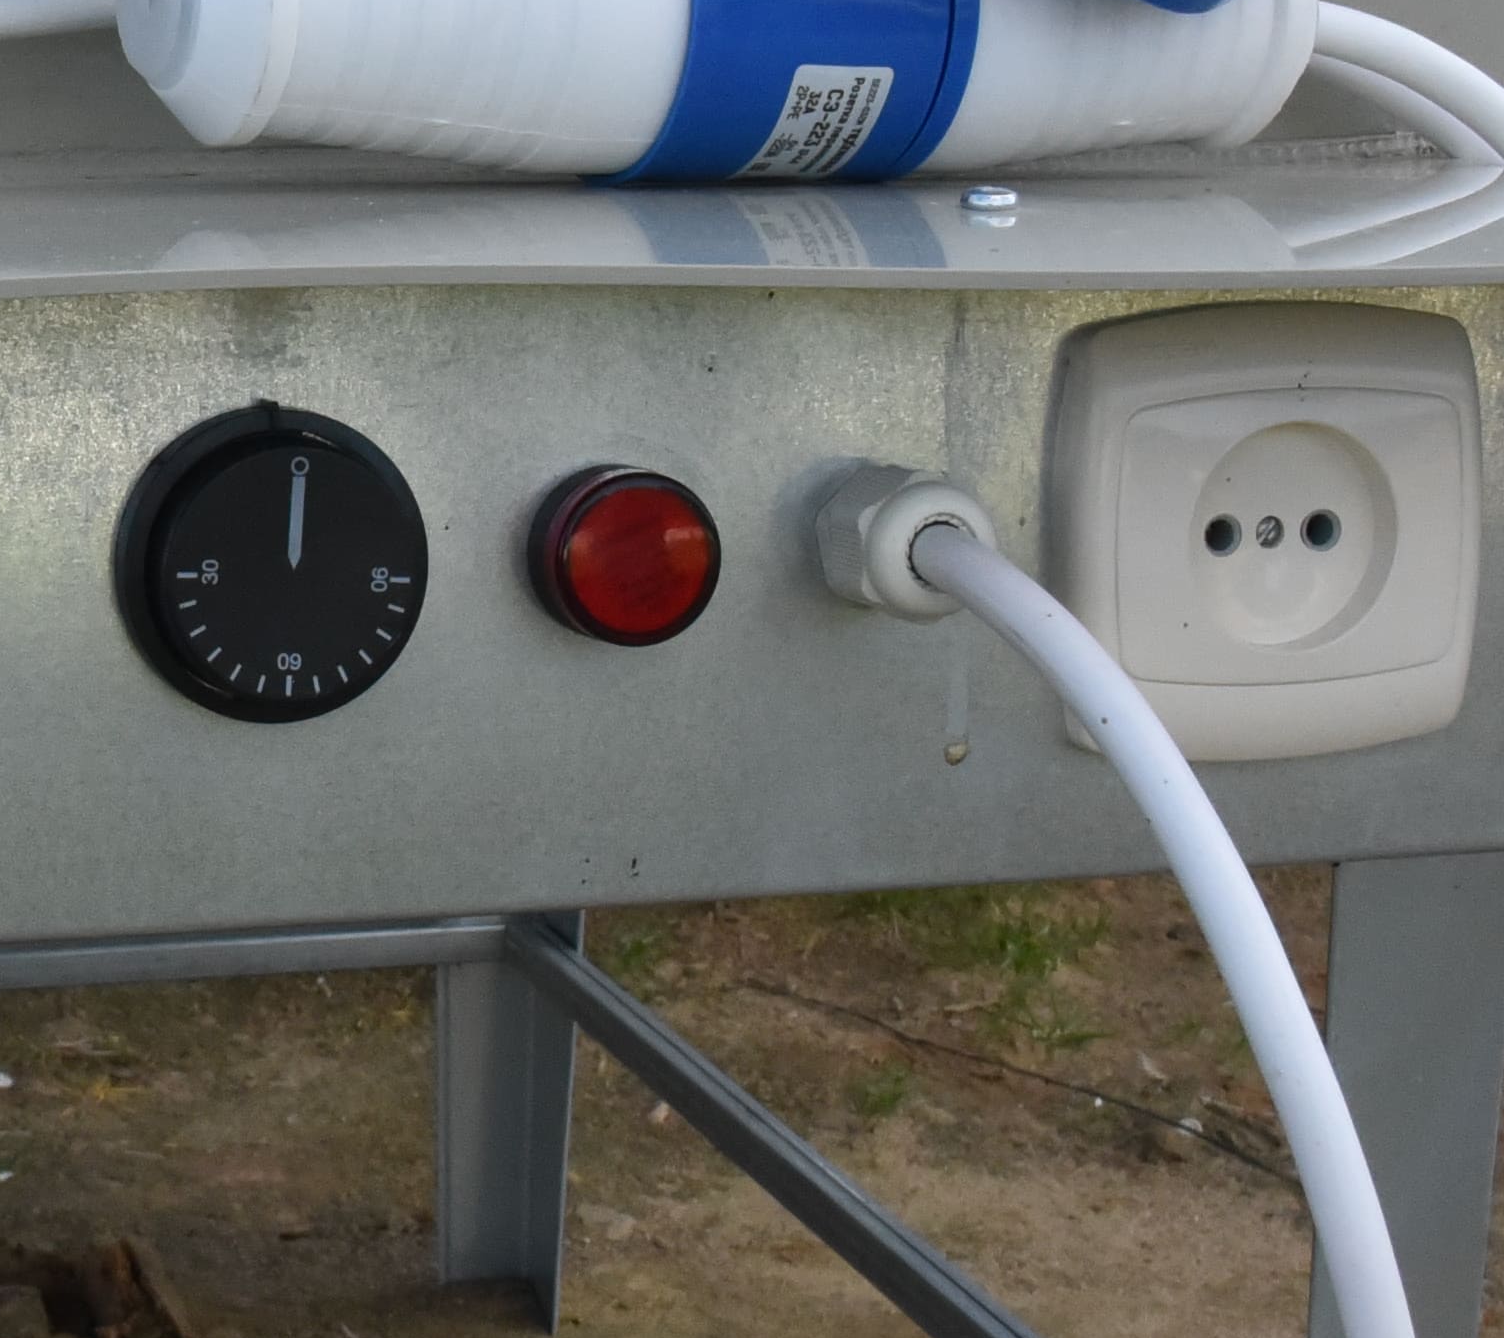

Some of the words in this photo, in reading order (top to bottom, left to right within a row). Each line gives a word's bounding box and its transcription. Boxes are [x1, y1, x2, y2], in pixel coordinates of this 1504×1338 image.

[837, 76, 866, 126] Розетка
[201, 559, 219, 585] 30
[370, 566, 389, 593] 90
[277, 652, 302, 670] 60
